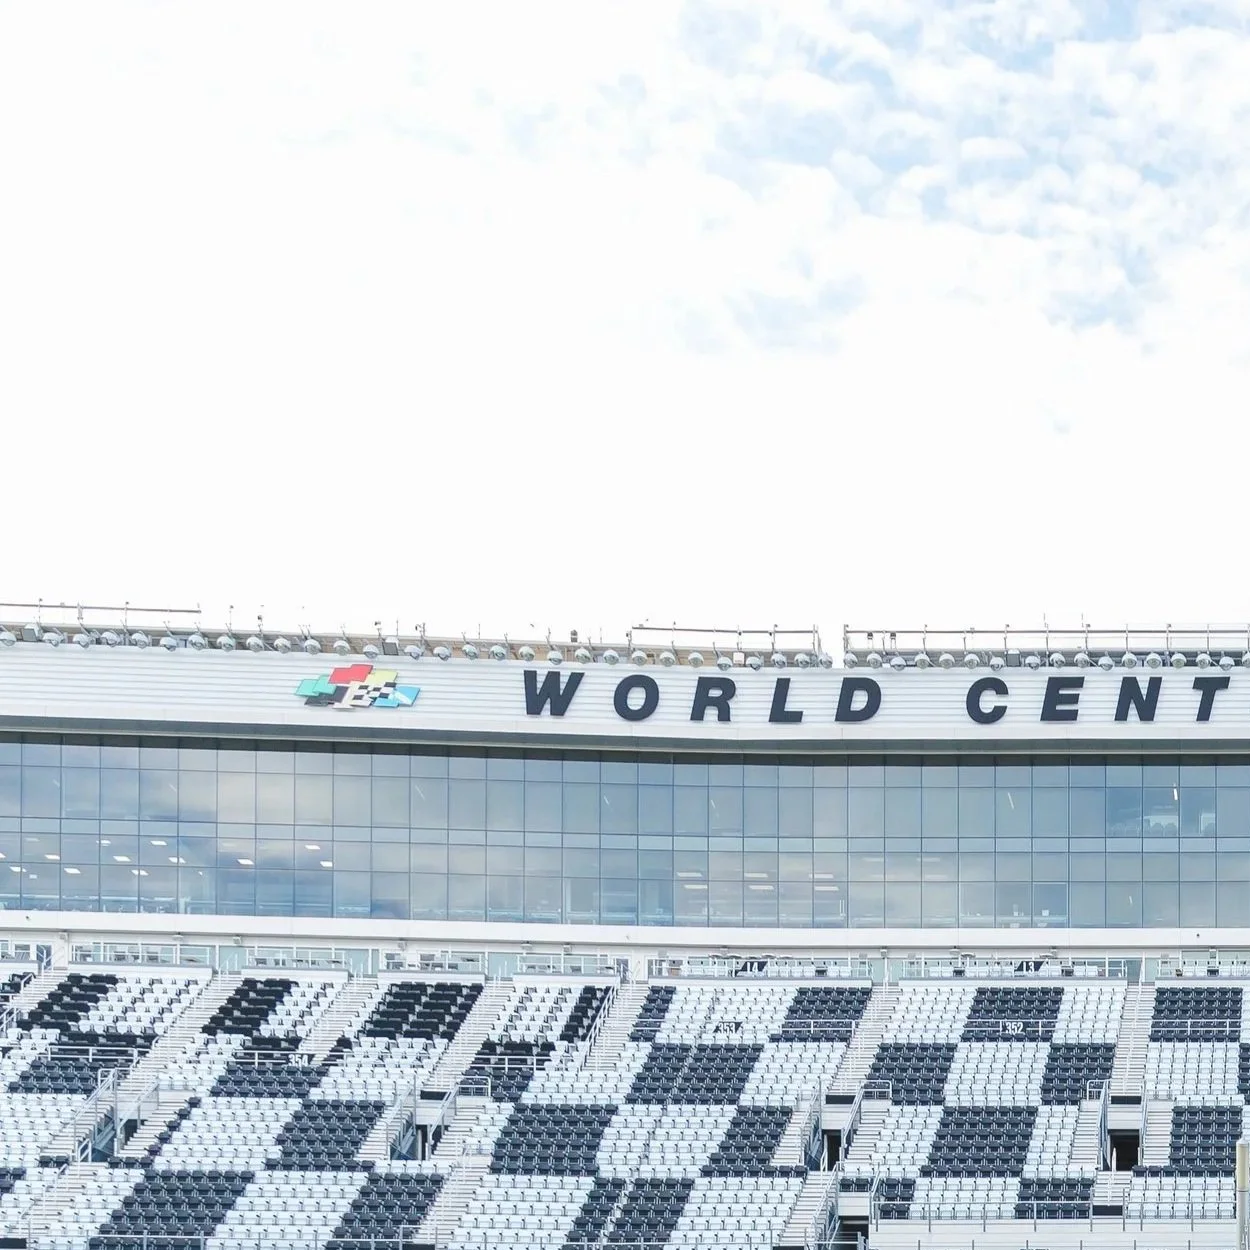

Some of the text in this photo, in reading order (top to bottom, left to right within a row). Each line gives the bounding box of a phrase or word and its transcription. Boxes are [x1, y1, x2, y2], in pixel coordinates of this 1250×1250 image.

[524, 670, 882, 722] WORLD
[1005, 1021, 1024, 1035] 352
[288, 1054, 308, 1067] 354
